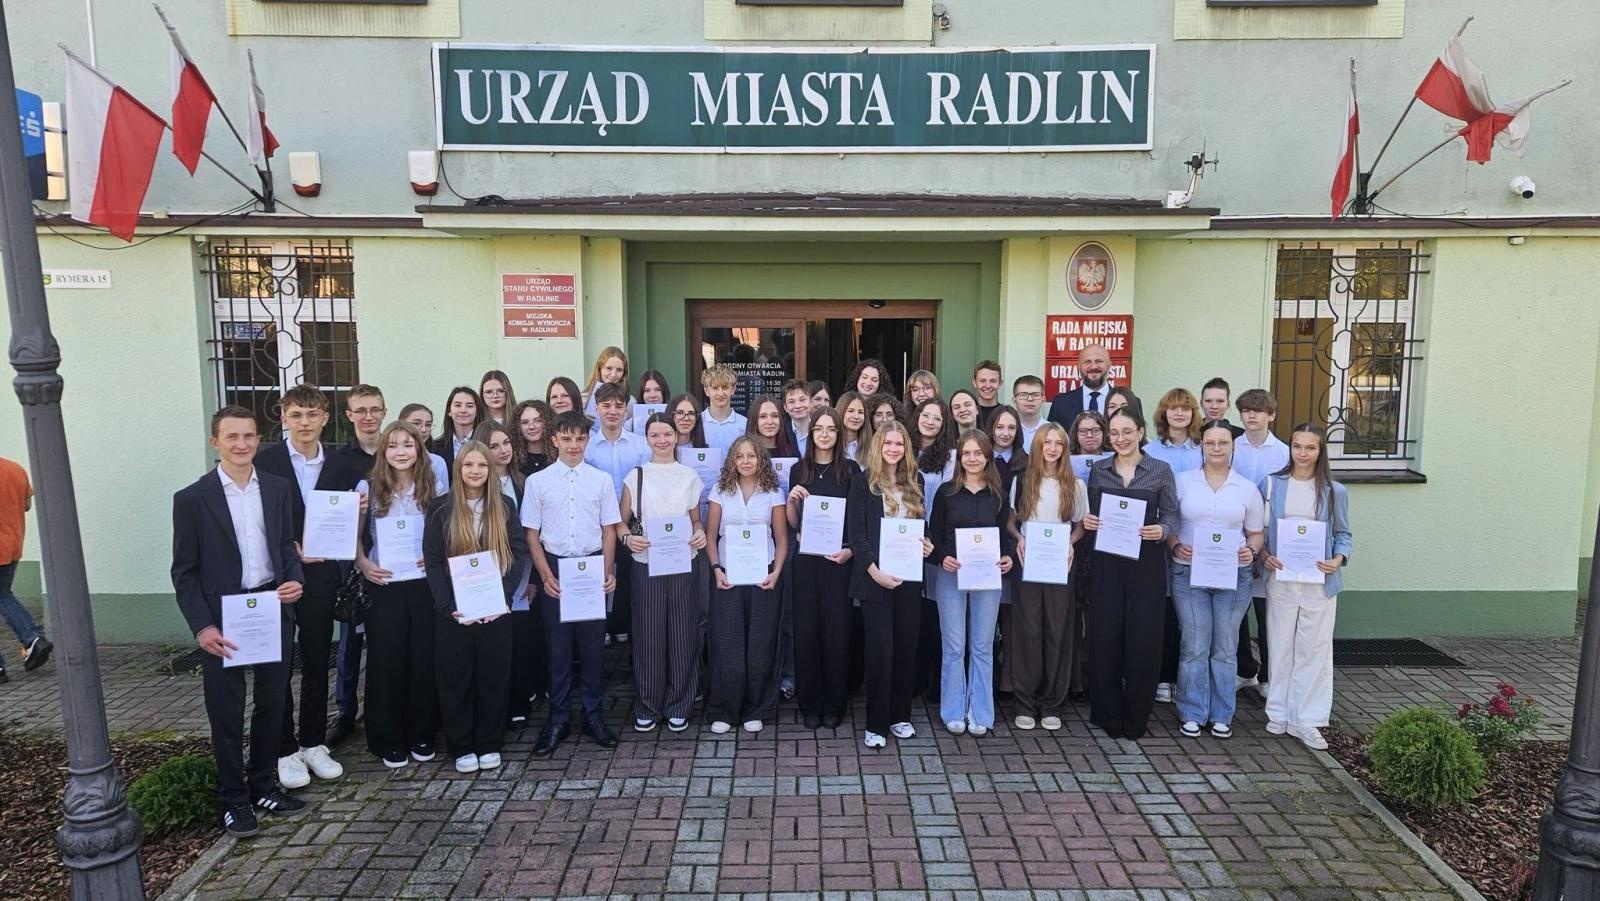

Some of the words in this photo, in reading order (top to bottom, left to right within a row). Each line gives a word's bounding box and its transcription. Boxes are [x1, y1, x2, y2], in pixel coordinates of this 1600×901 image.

[453, 69, 650, 137] URZĄD
[688, 71, 895, 126] MIASTA
[926, 70, 1140, 125] RADLIN
[56, 274, 96, 284] RYMERA
[97, 274, 108, 284] 15
[526, 278, 551, 286] URZĄD
[529, 285, 574, 293] CYWILNEGO
[1052, 321, 1080, 334] RADA
[1083, 320, 1128, 336] MIEJSKA
[1056, 337, 1066, 351] W
[1051, 365, 1082, 380] URZĄ
